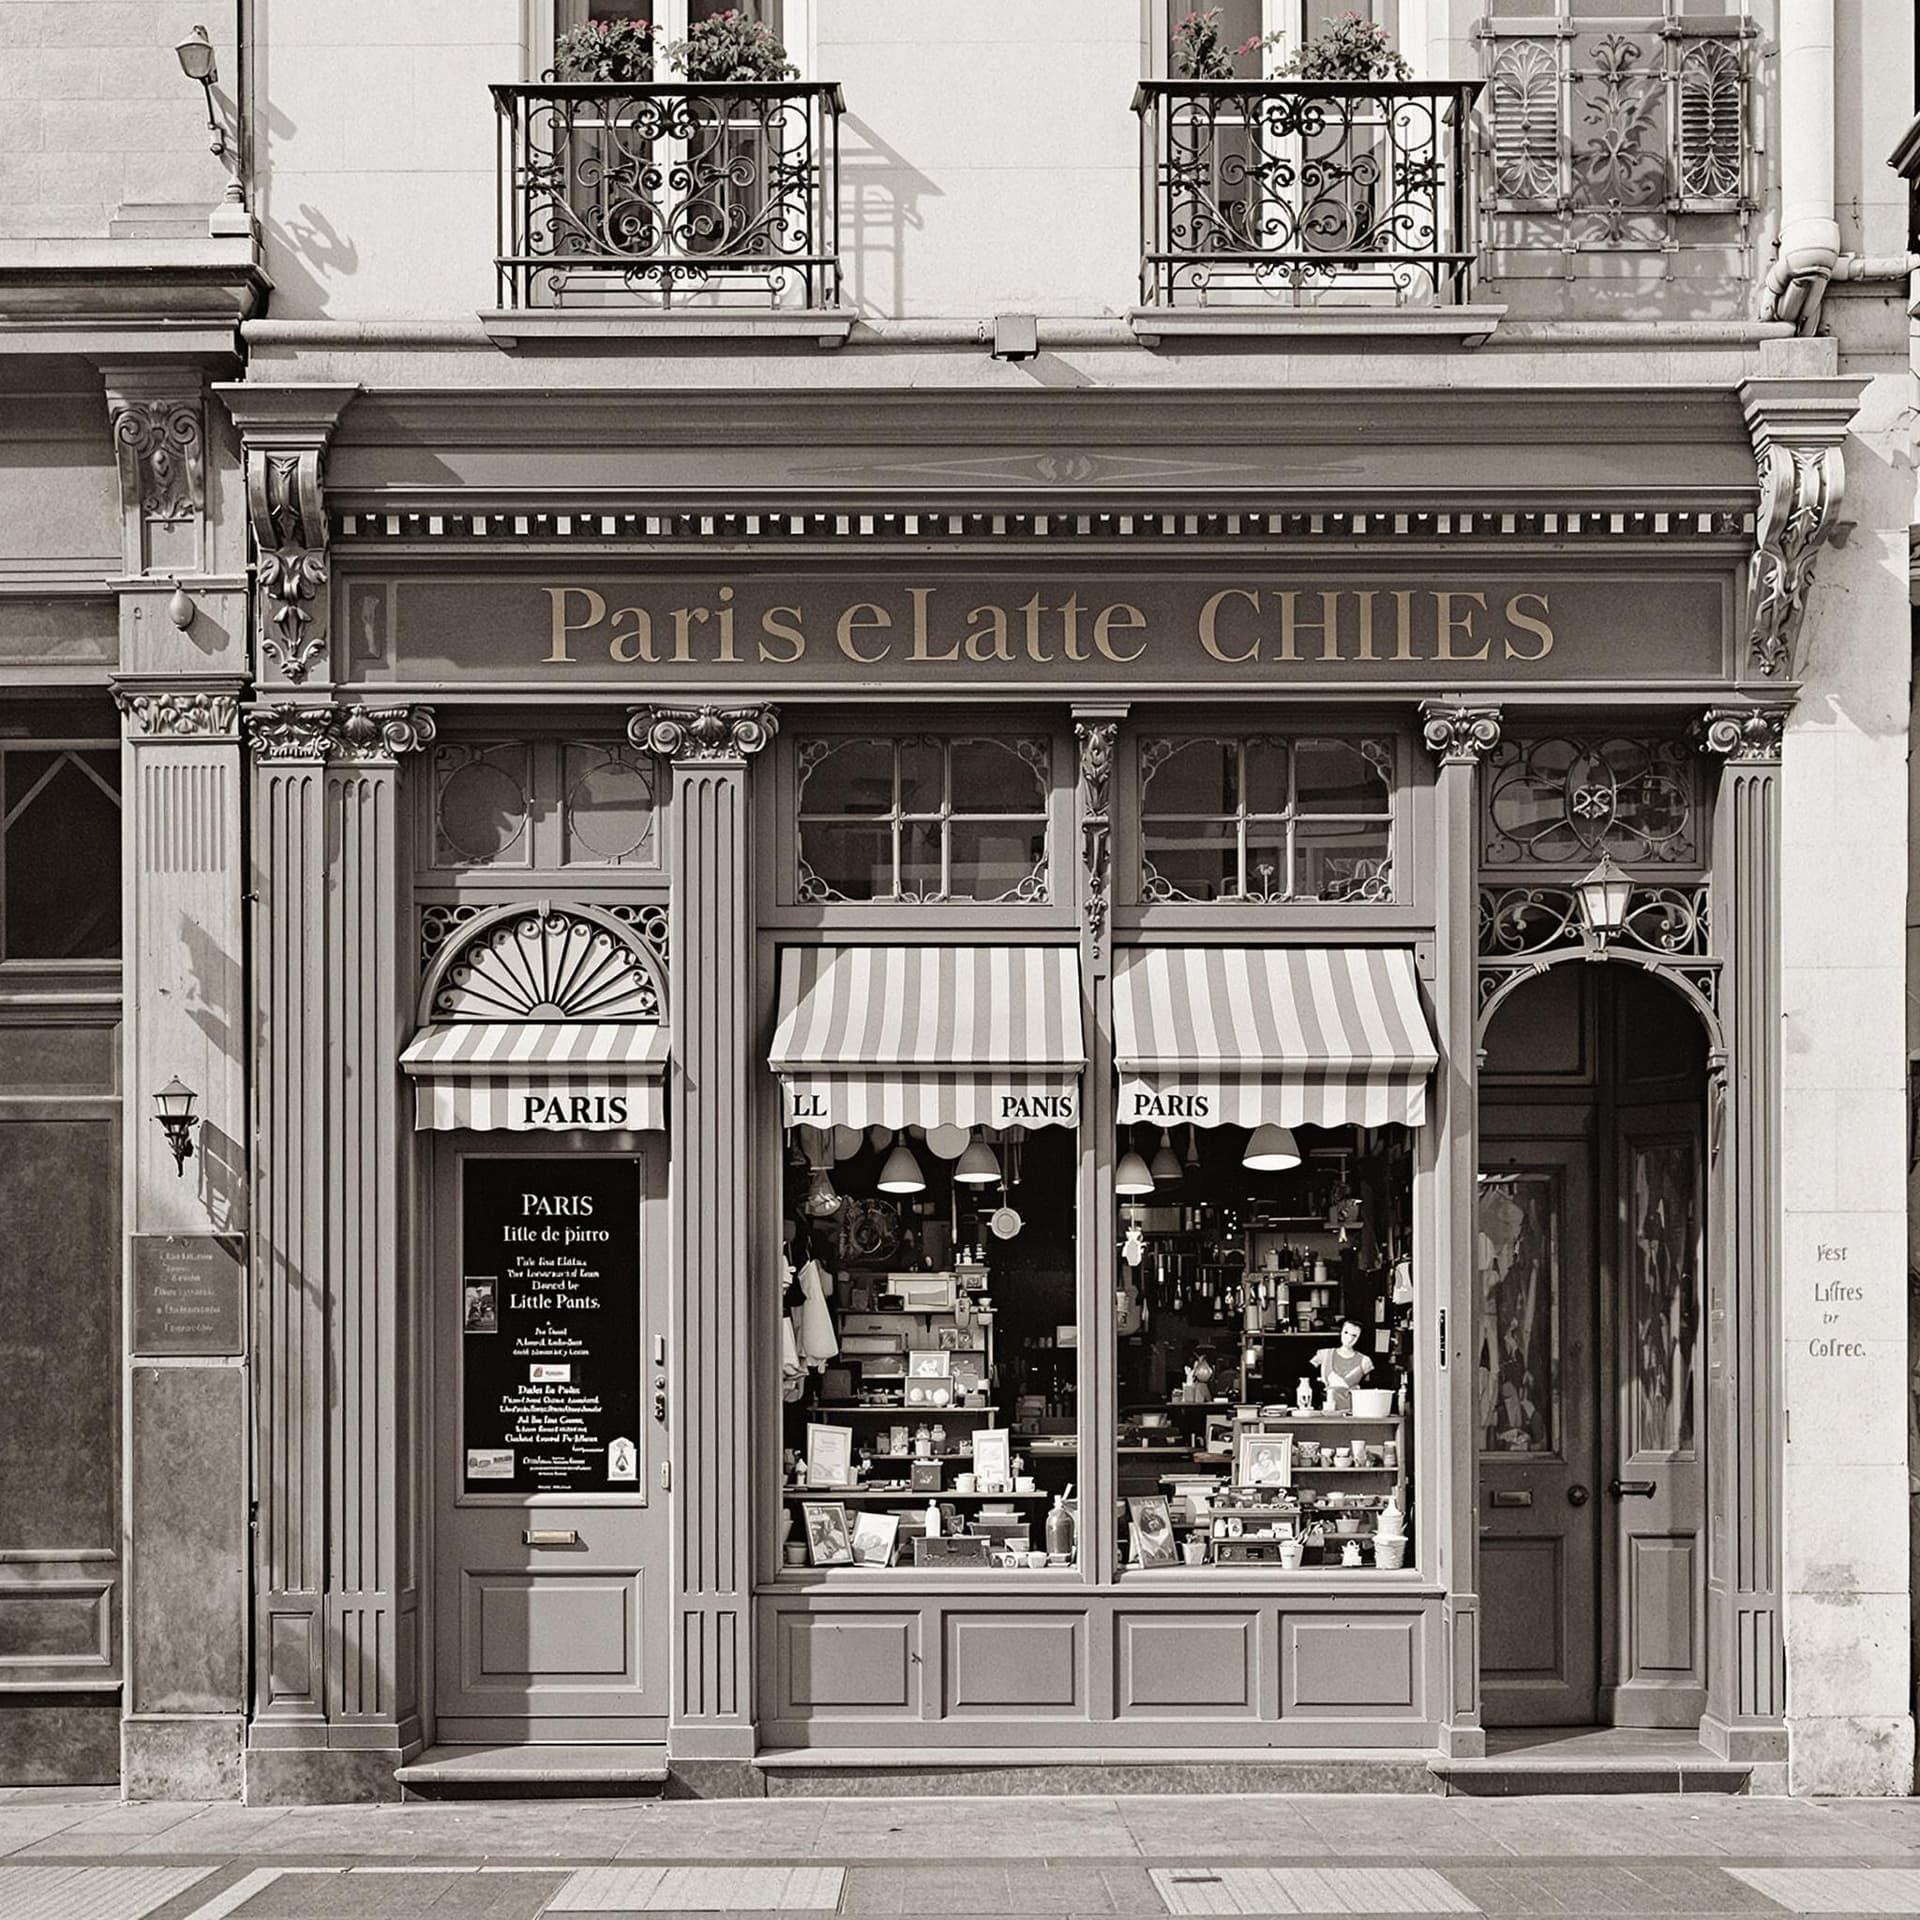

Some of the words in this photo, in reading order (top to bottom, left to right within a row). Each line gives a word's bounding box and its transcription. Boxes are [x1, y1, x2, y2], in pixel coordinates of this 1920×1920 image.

[542, 586, 806, 663] Paris
[1198, 590, 1555, 662] CHIIES
[523, 1096, 628, 1124] PARIS
[793, 1094, 828, 1117] LL
[1001, 1095, 1074, 1118] PANIS
[1134, 1094, 1209, 1118] PARIS
[521, 1193, 594, 1216] PARIS
[510, 1293, 553, 1309] Little
